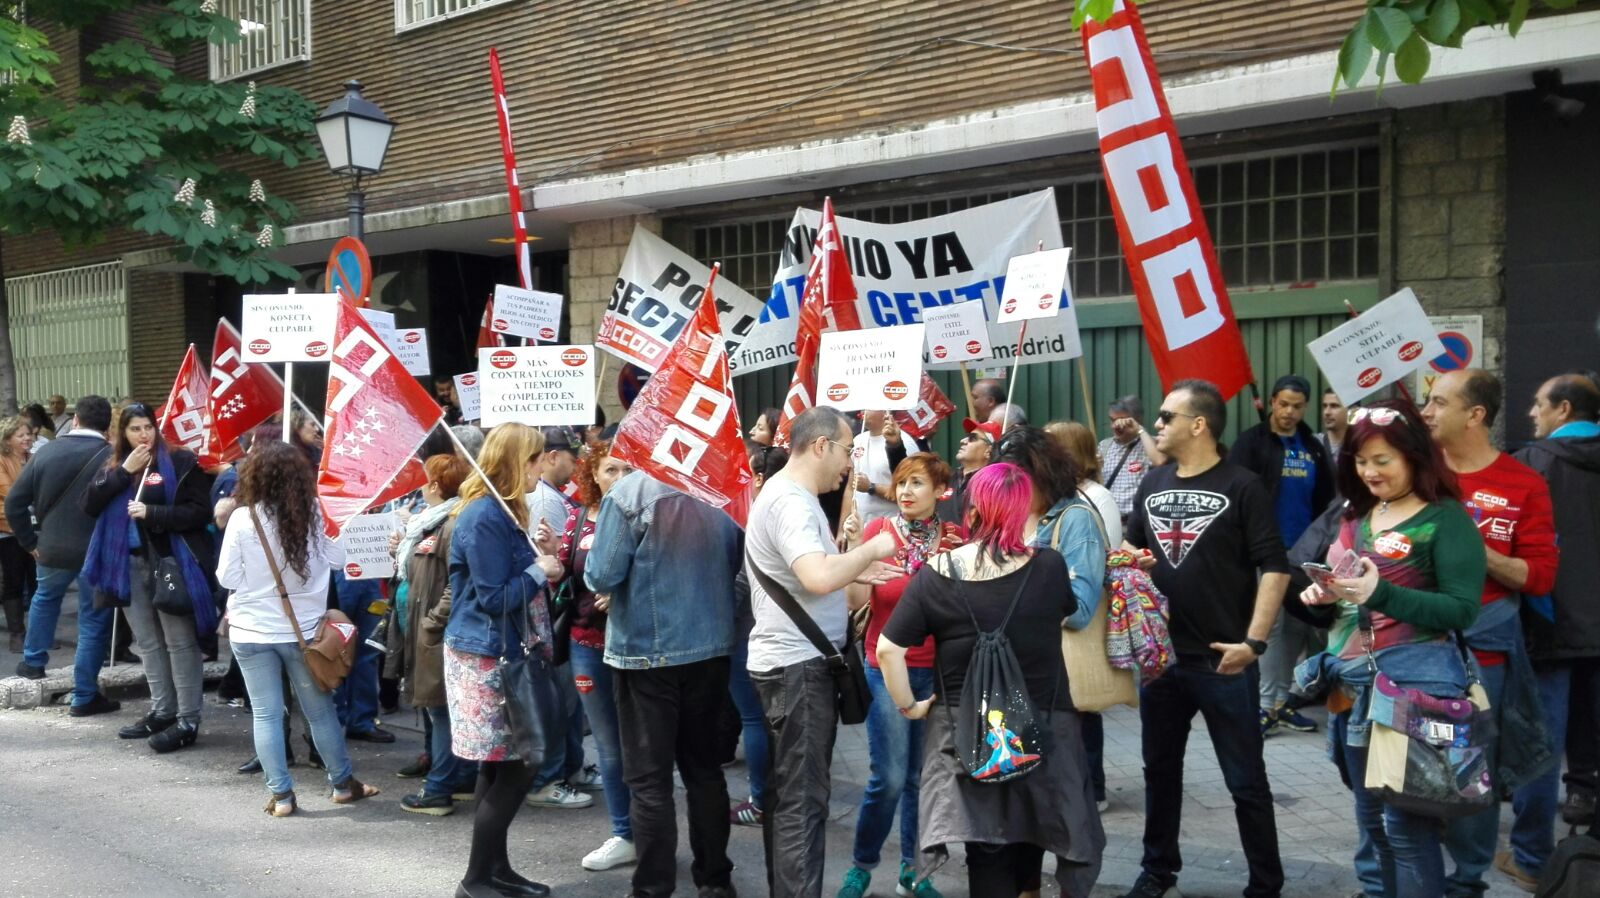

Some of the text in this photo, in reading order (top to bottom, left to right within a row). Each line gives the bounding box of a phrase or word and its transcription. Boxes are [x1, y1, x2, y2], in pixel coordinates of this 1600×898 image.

[895, 231, 975, 279] YA
[506, 294, 545, 306] ACOMPAÑAR
[500, 308, 518, 316] HIJOS
[519, 304, 542, 313] PADRES
[270, 313, 312, 322] KONECTA
[269, 325, 314, 333] CULPABLE
[520, 320, 540, 329] COSTE
[944, 321, 962, 329] EXTEL
[941, 329, 970, 339] CULPABLE
[610, 324, 663, 360] CCOO
[1358, 330, 1385, 349] SITEL
[992, 333, 1066, 360] madrid
[1324, 344, 1338, 354] SIN
[1355, 332, 1405, 365] CULPABLE
[491, 355, 517, 363] CCOO
[562, 353, 587, 361] CCOO
[1358, 342, 1422, 387] CCOO CCOO
[491, 369, 585, 380] CONTRATACIONES
[524, 381, 563, 390] TIEMPO
[883, 386, 909, 394] CCOO
[501, 392, 575, 401] COMPLETO EN
[492, 402, 585, 413] CONTACT CENTER
[1475, 492, 1508, 507] CCOO
[344, 524, 385, 534] ACOMPAÑAR
[349, 536, 387, 545] TUS PADRES
[370, 556, 391, 564] COSTE
